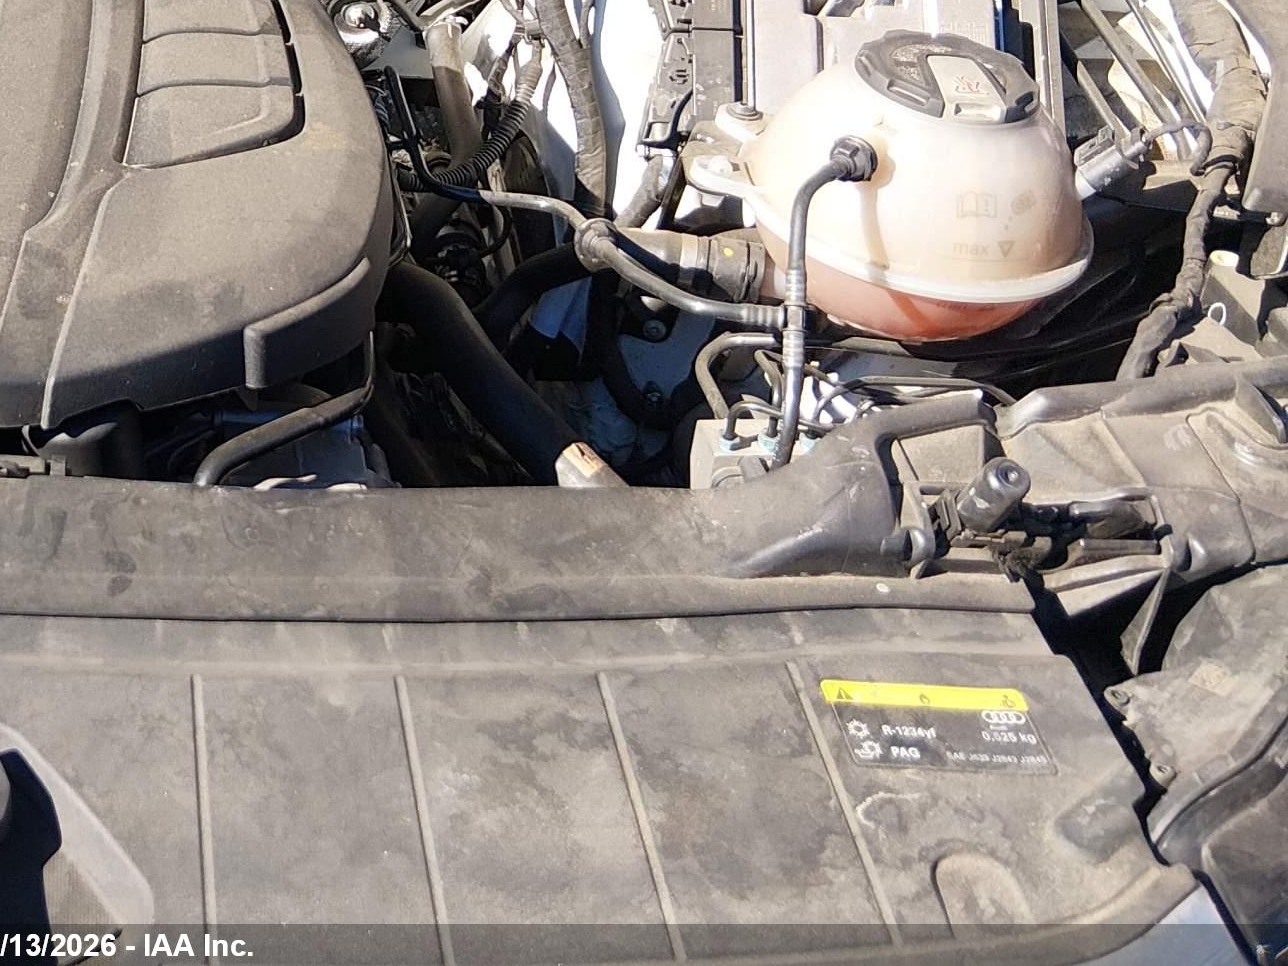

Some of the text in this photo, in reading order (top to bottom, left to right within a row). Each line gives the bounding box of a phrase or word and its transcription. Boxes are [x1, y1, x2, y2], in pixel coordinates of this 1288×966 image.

[952, 241, 990, 256] max
[881, 724, 937, 739] R-1234yf
[889, 746, 921, 759] PAG
